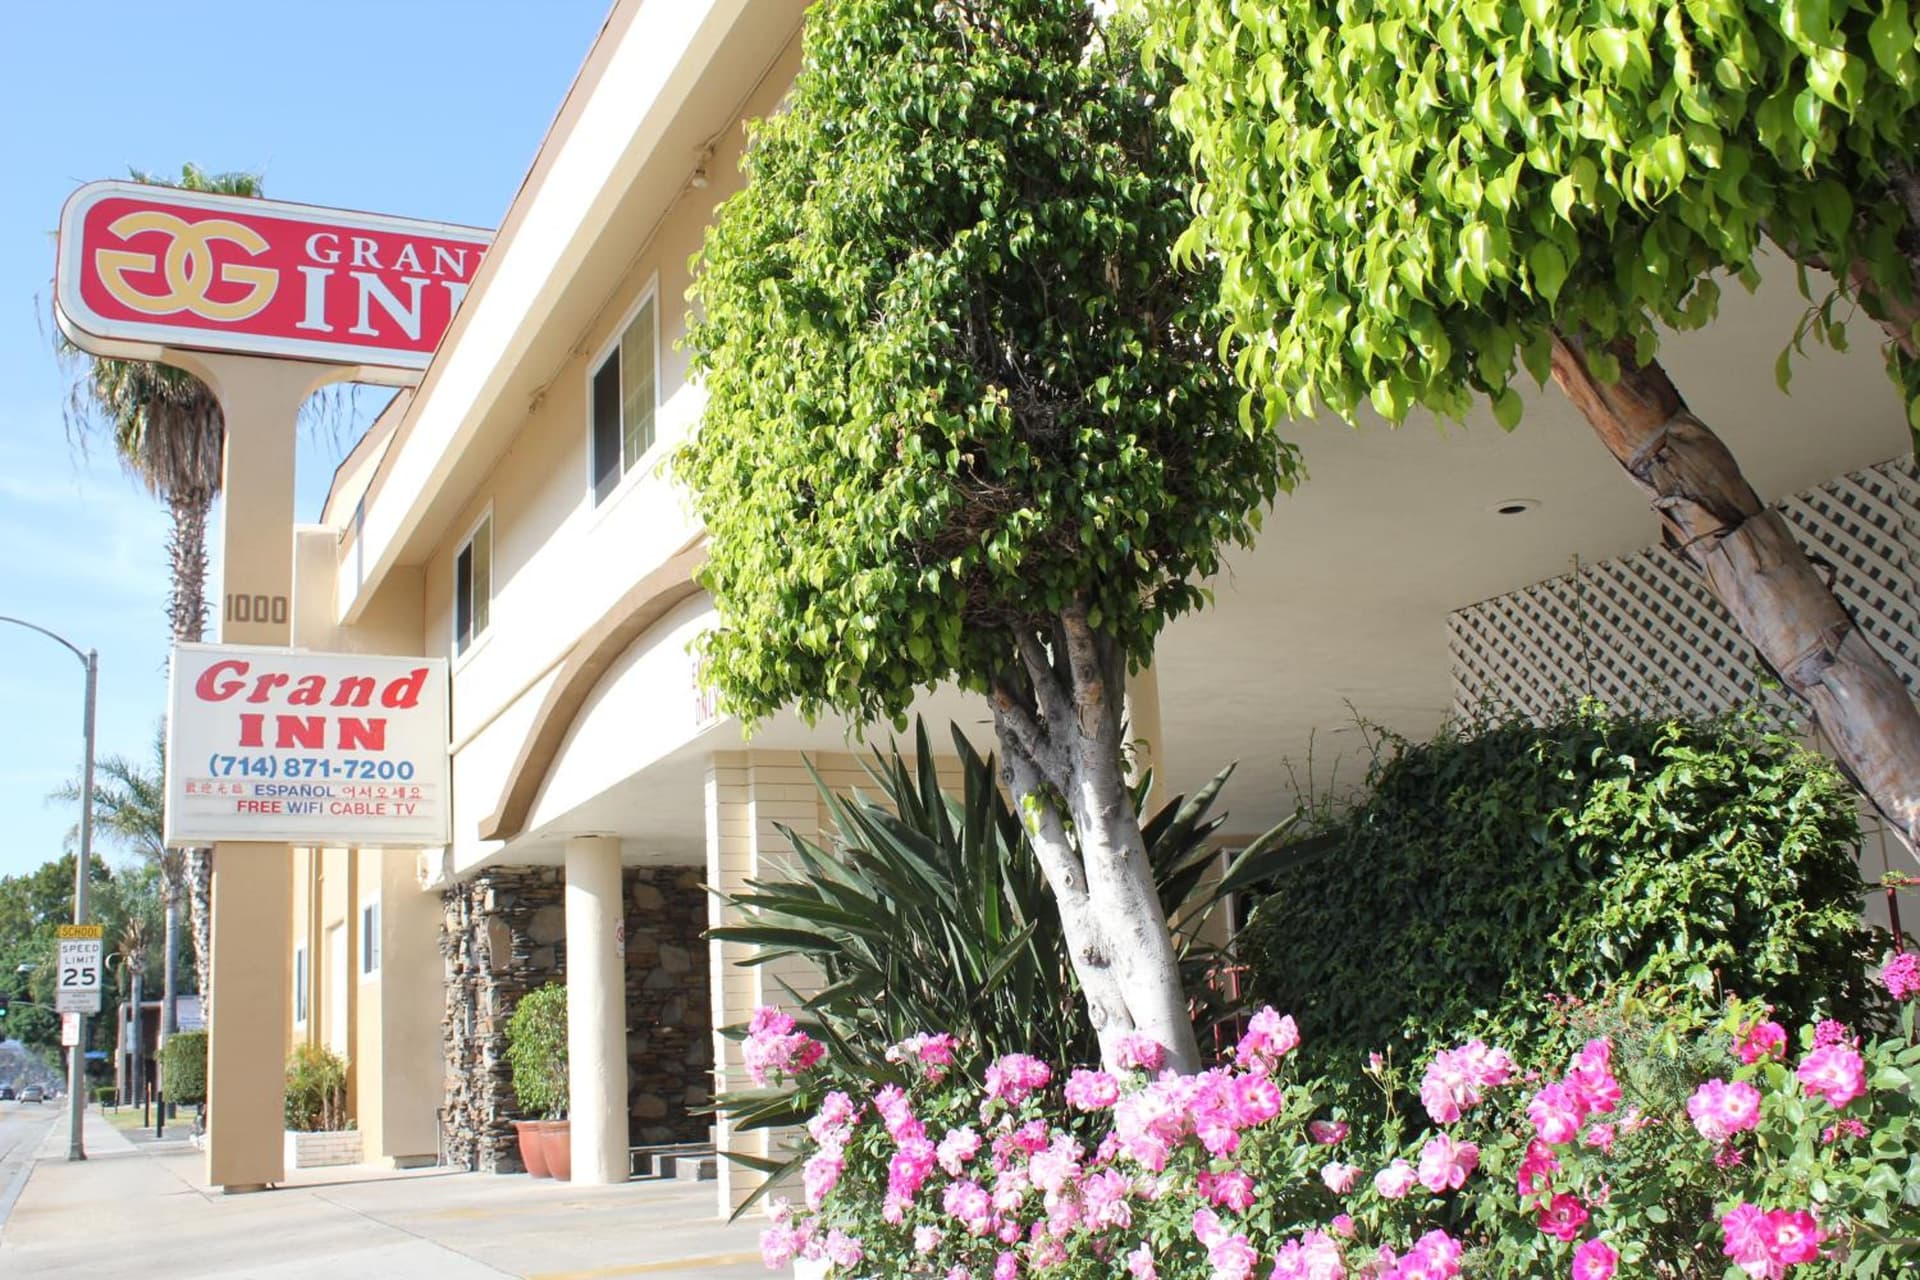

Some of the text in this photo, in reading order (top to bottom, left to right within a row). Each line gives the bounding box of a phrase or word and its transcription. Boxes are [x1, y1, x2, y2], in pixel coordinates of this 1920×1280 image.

[305, 231, 487, 279] GRAN
[226, 594, 287, 624] 1000
[195, 660, 430, 709] Grand
[239, 713, 387, 752] INN
[209, 753, 414, 781] (714) 871-7200
[254, 783, 335, 798] ESPAÑOL
[342, 786, 423, 800] 어서오세요
[237, 800, 416, 816] FREE WIFI CABLE TV
[62, 925, 98, 937] SCHOOL
[62, 943, 99, 953] SPEED
[65, 956, 95, 965] LIMIT
[63, 968, 96, 986] 25
